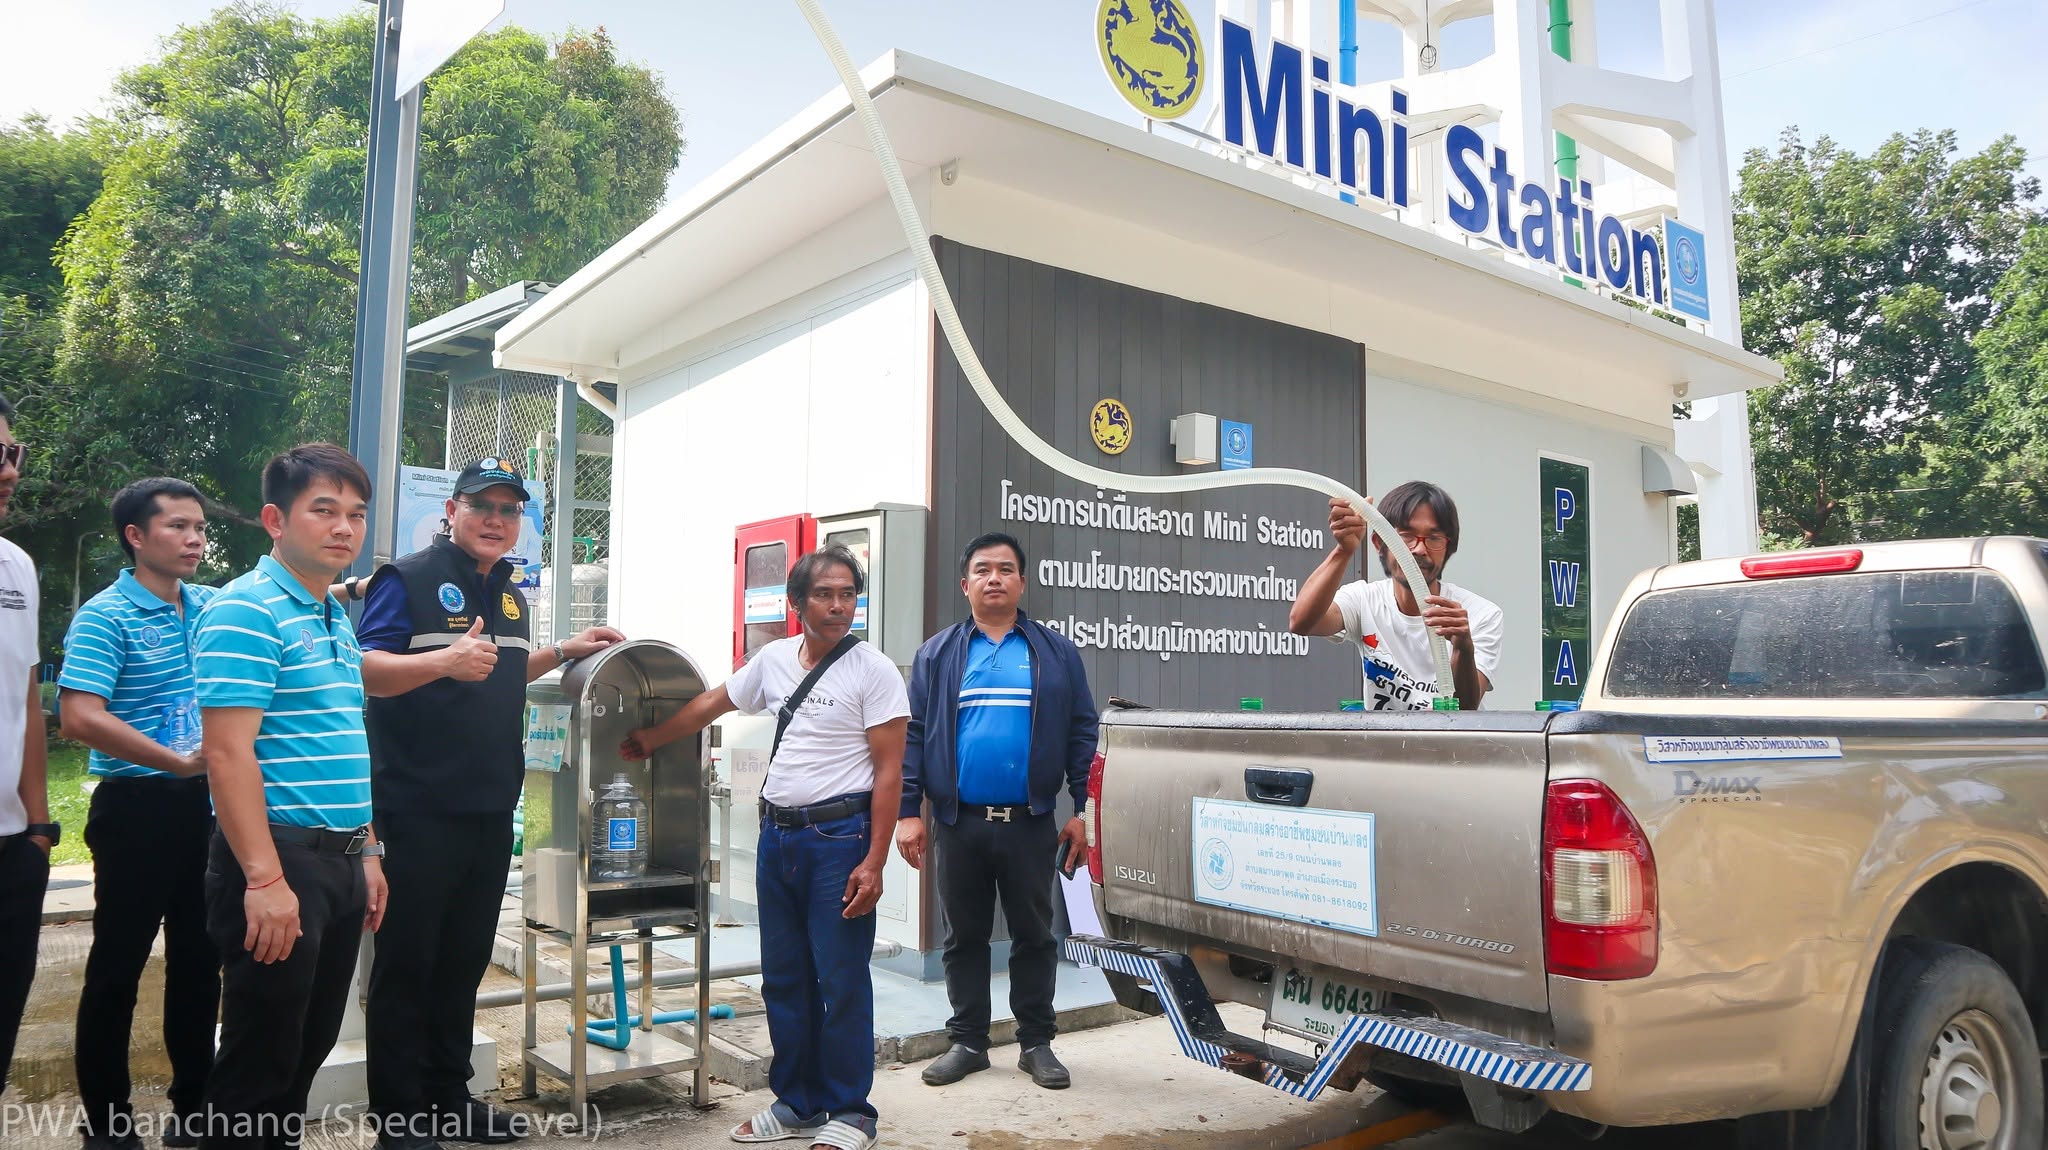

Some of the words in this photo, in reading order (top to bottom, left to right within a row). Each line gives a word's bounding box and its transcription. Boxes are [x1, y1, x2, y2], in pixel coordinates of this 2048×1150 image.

[1220, 15, 1409, 210] Mini
[1445, 122, 1664, 306] Station
[1001, 479, 1194, 537] โครงการนำดืมสะอาด
[1204, 510, 1247, 542] Mini
[1257, 515, 1324, 549] Station
[1039, 550, 1297, 602] ตามนโยบายกระทรวงมหาดไทย
[1036, 615, 1309, 661] รประปาส่วนภูมิภาคสาขาบ้านฉาง
[783, 695, 835, 706] OGINALS
[1679, 795, 1762, 804] SPACECAB
[1276, 850, 1293, 860] 25/9
[1115, 865, 1156, 885] ISUZU
[1312, 893, 1368, 912] 081-8618092
[1442, 931, 1516, 954] TURBO
[1304, 1017, 1335, 1036] ระยอง
